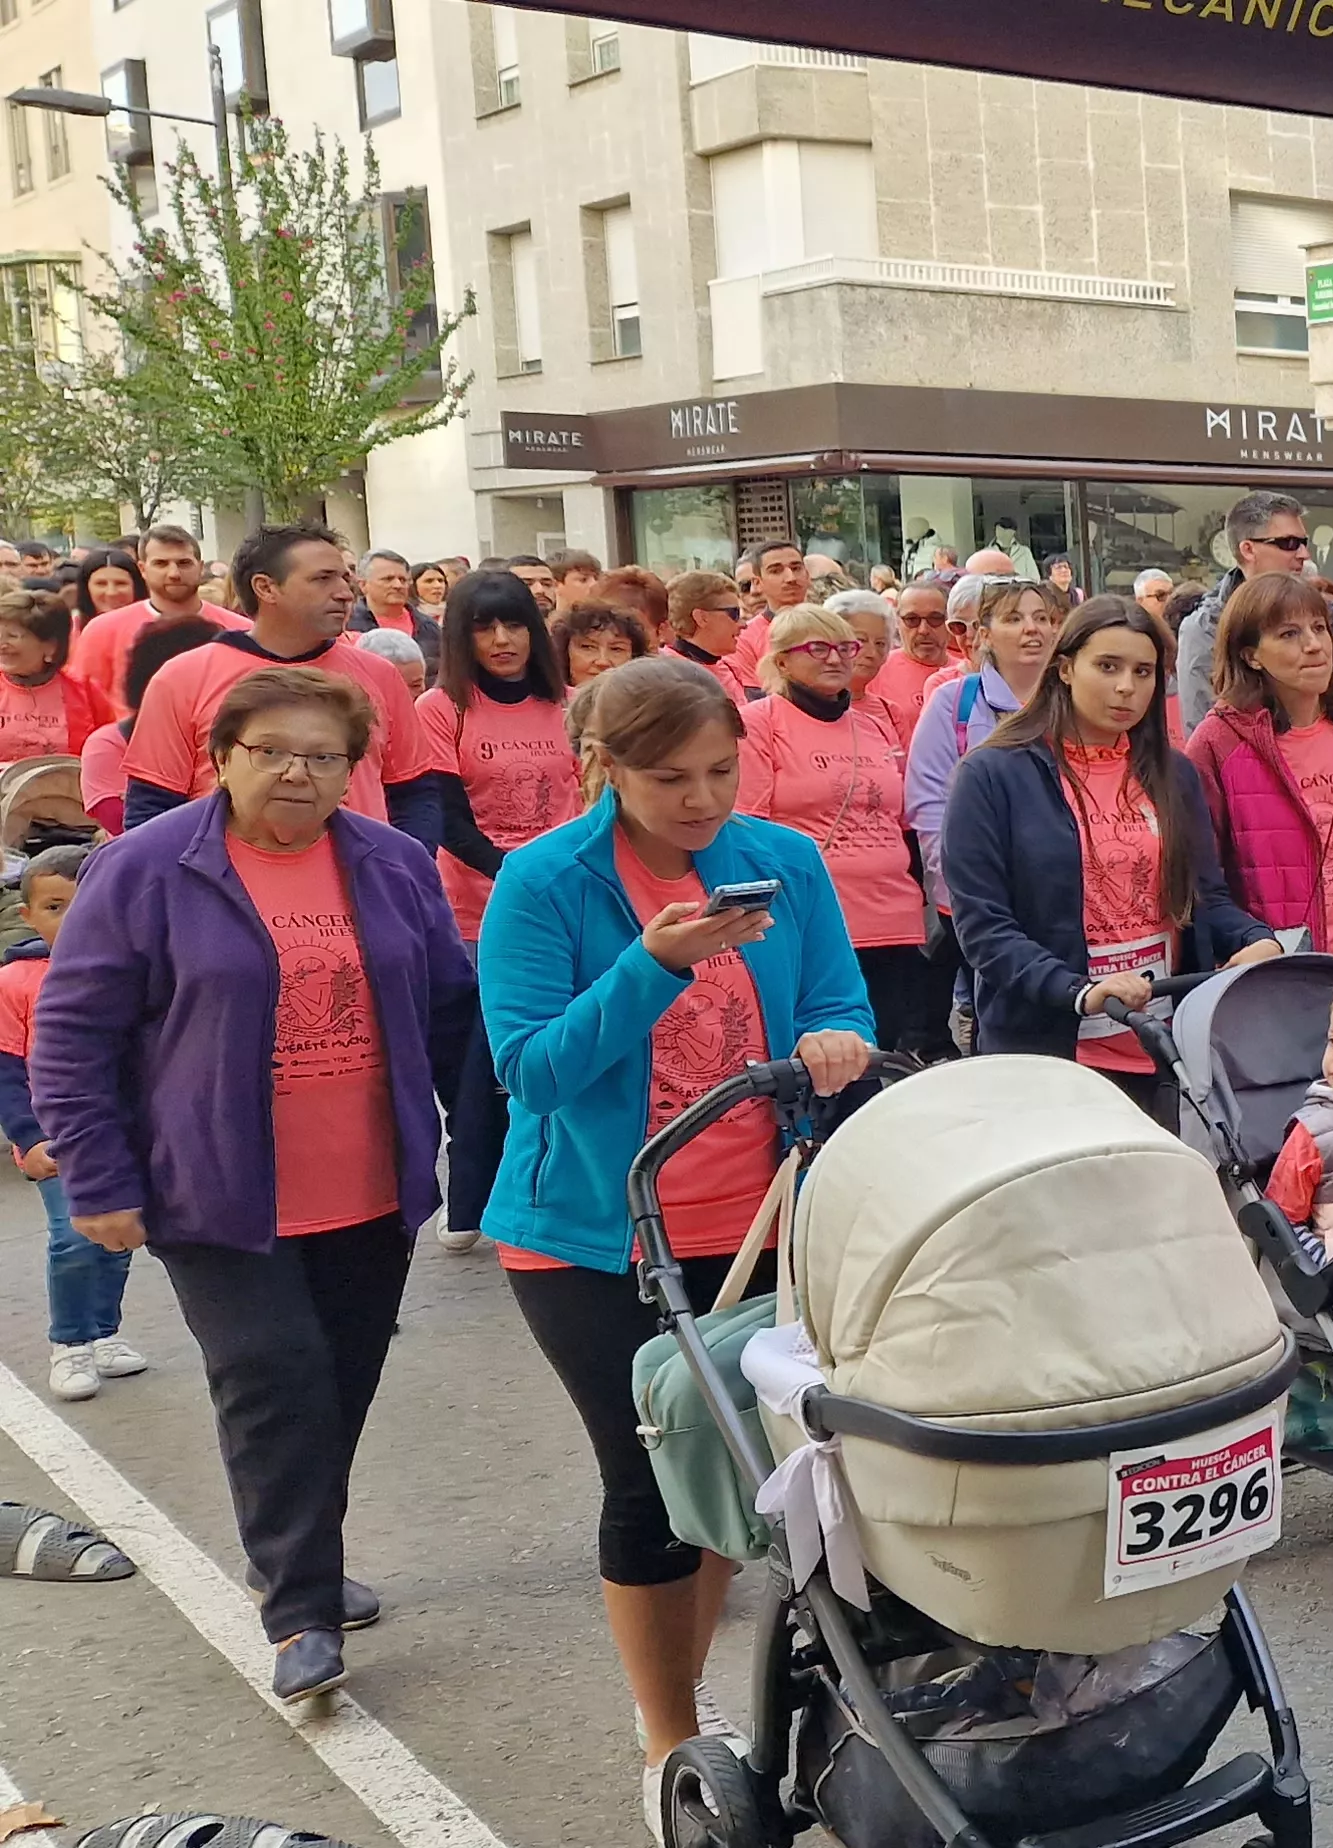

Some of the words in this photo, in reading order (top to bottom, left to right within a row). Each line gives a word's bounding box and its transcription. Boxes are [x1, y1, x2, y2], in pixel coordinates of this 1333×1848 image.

[670, 401, 740, 438] MIRATE
[508, 429, 584, 447] MIRATE
[1240, 449, 1324, 462] MENSWEAR
[501, 739, 556, 750] CÁNCER
[1088, 964, 1118, 976] NTRA
[1120, 960, 1131, 970] EL
[1131, 951, 1162, 967] CÁNCER
[1107, 951, 1137, 963] HUESCA
[276, 1039, 329, 1054] UIÉRETE
[331, 1035, 371, 1049] MUCHO
[1131, 1471, 1202, 1494] CONTRA
[1205, 1466, 1220, 1481] EL
[1223, 1444, 1267, 1474] CÁNCER
[1191, 1449, 1232, 1471] HUESCA
[1126, 1466, 1269, 1556] 3296
